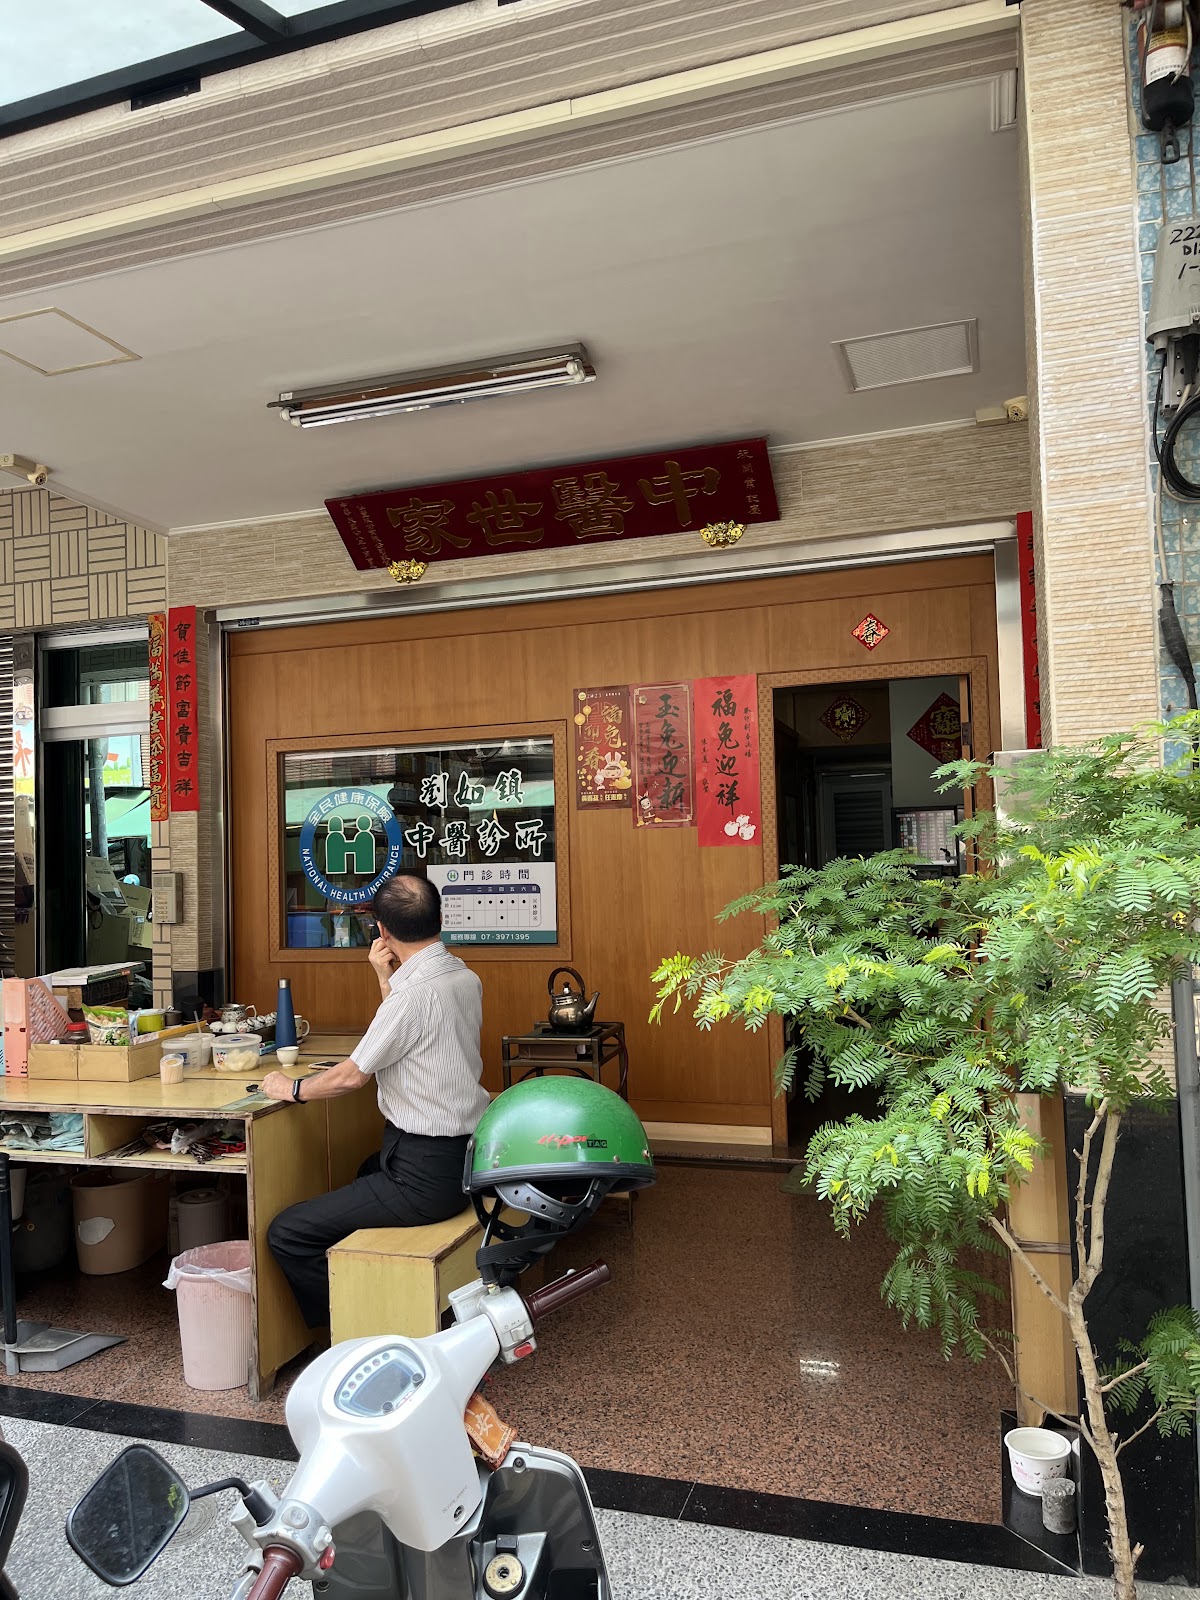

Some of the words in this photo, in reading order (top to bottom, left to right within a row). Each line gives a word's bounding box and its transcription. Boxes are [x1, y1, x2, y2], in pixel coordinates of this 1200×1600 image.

[385, 459, 722, 556] 中醫世家
[860, 618, 881, 643] 春
[173, 622, 194, 797] 賀佳節富貴吉祥
[654, 693, 687, 814] 玉兔迎新
[710, 688, 740, 816] 福兔迎祥
[308, 791, 393, 827] 全民健康保險
[419, 767, 525, 809] 劉如鎮
[404, 818, 548, 859] 中醫診所
[302, 848, 328, 893] NATIONAL
[329, 888, 366, 901] HEALTH
[463, 868, 530, 881] 門診時間
[587, 1140, 608, 1148] TAG
